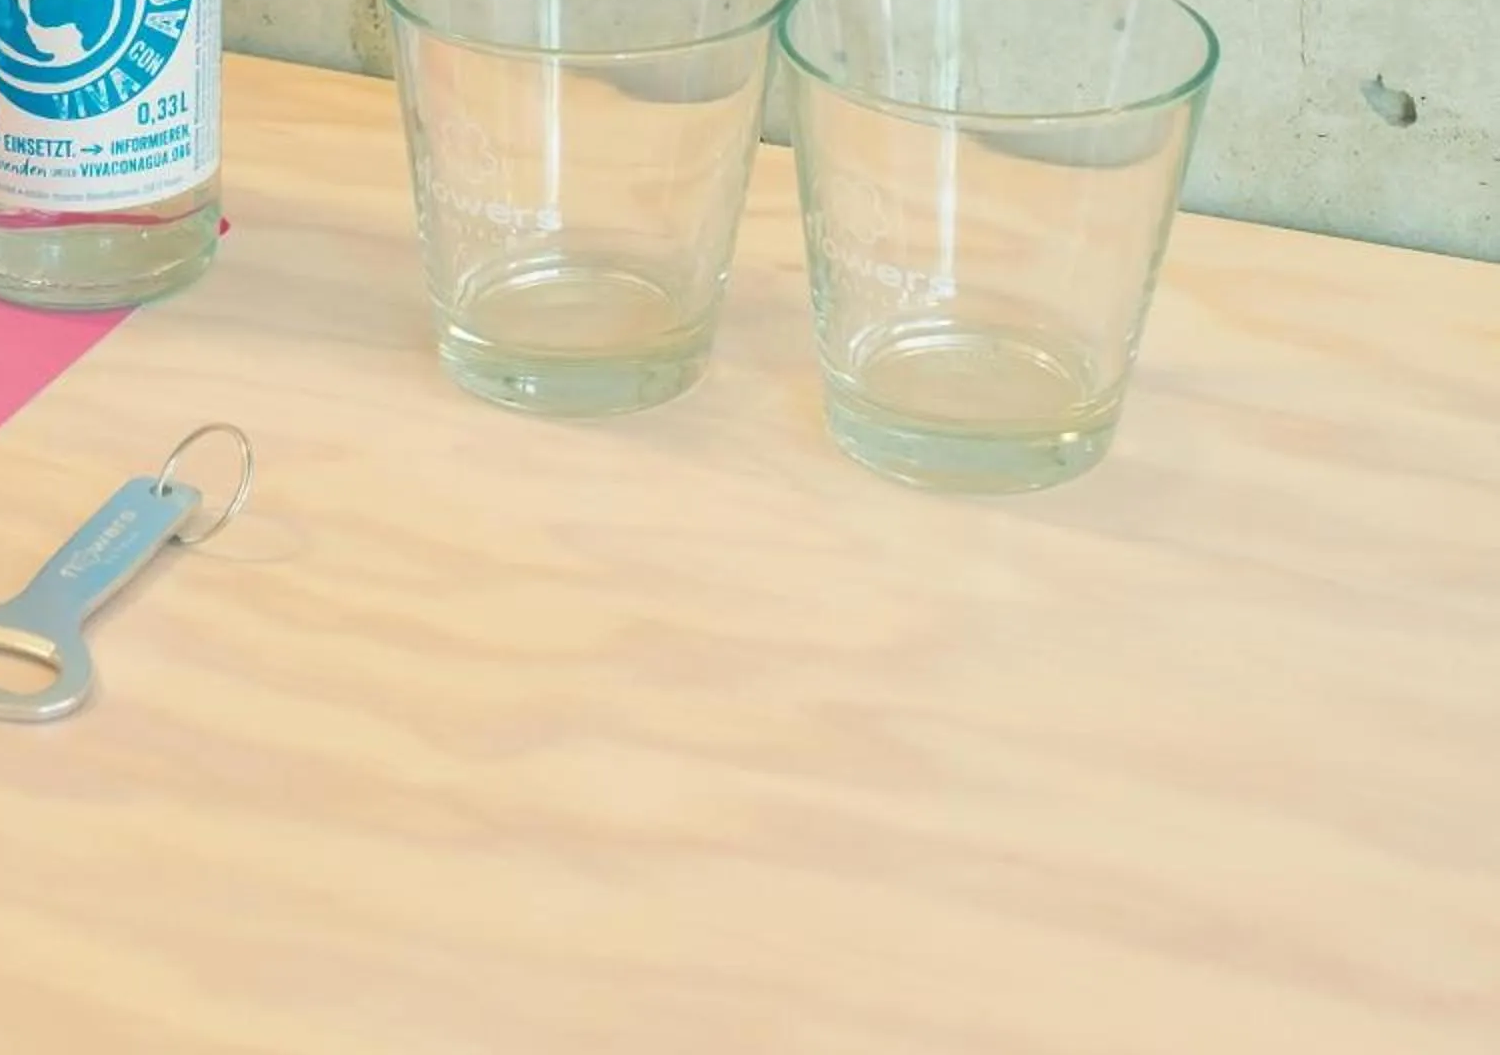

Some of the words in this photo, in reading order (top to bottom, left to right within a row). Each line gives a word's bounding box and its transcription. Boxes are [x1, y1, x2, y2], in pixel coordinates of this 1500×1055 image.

[52, 65, 142, 120] VIVA
[127, 39, 166, 78] CON
[79, 144, 192, 179] VIVACONAGUA.ORG
